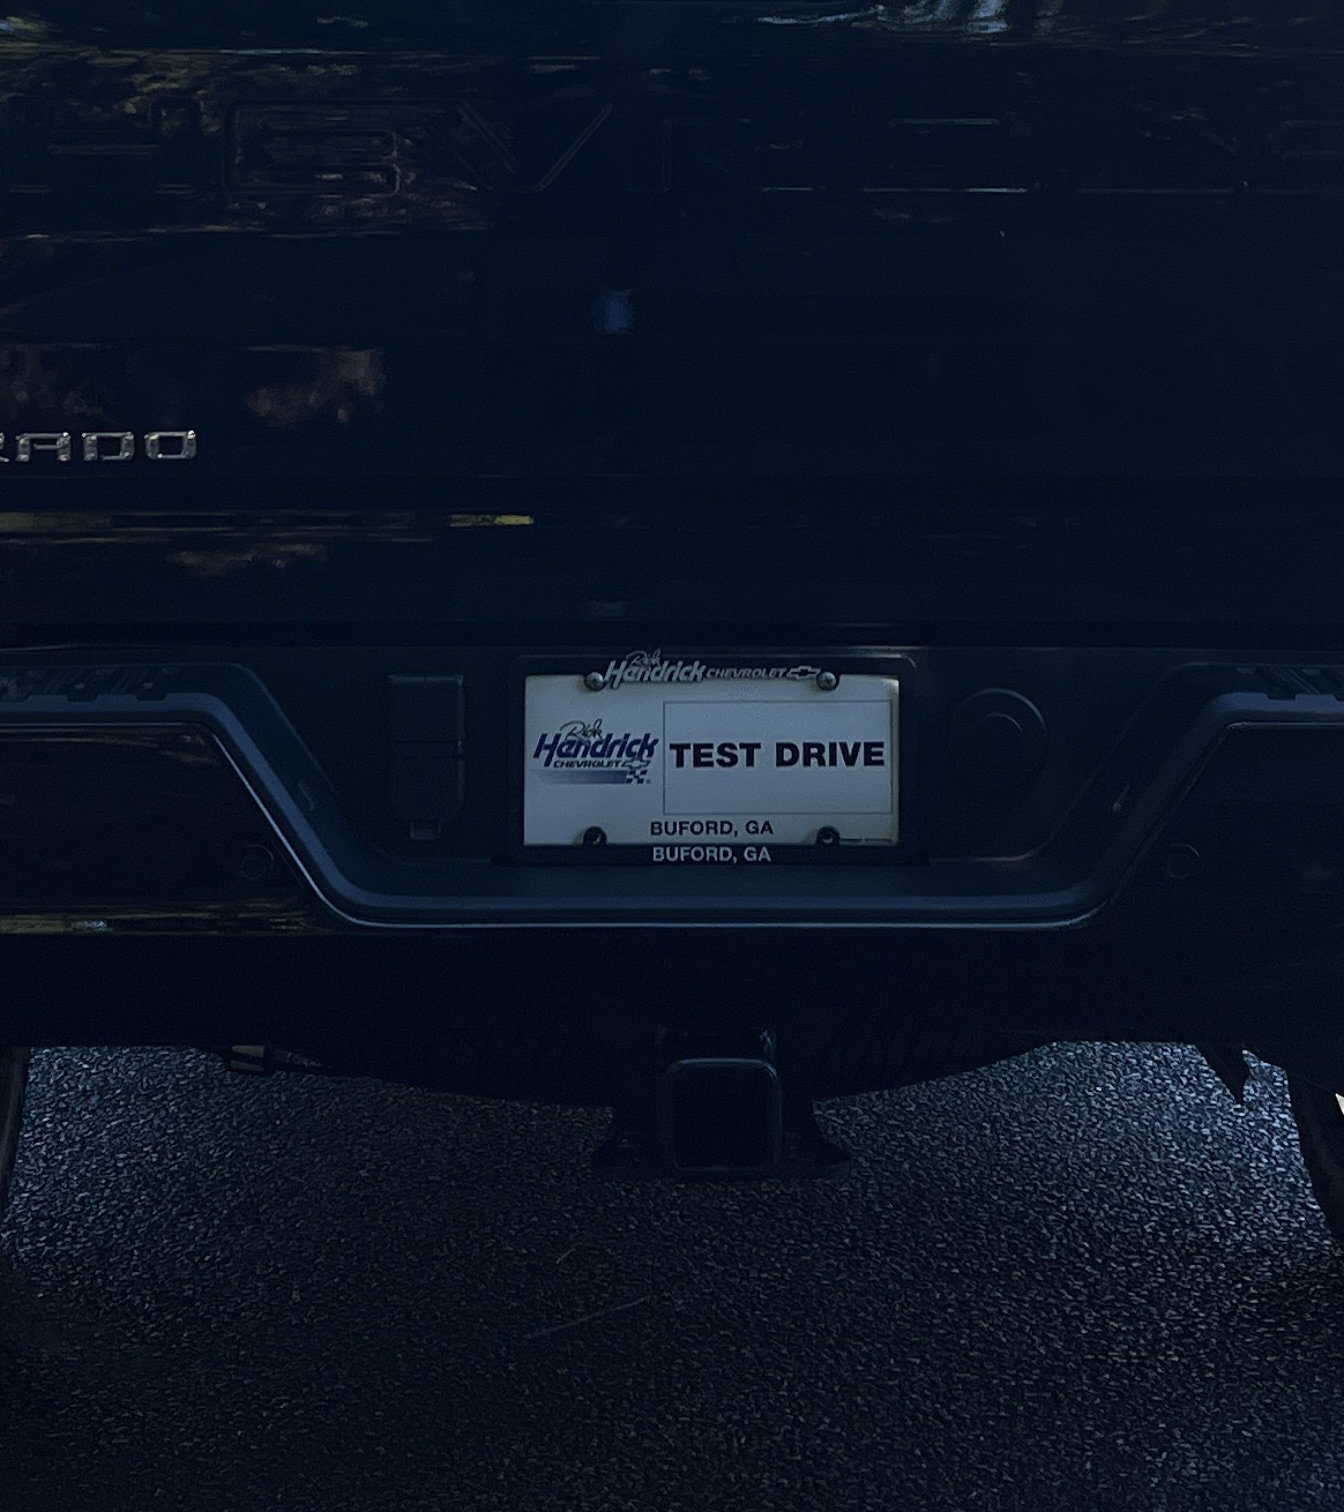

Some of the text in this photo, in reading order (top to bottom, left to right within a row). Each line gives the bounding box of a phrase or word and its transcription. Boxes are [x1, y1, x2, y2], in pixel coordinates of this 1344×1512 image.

[603, 659, 787, 689] Hendrick CHEVROLET
[560, 718, 603, 739] Rick
[533, 732, 659, 767] Hendrick
[669, 740, 885, 769] TEST DRIVE
[553, 759, 623, 769] CHEVROLET
[650, 820, 775, 838] BUFORD, GA
[653, 846, 773, 864] BUFORD, GA
